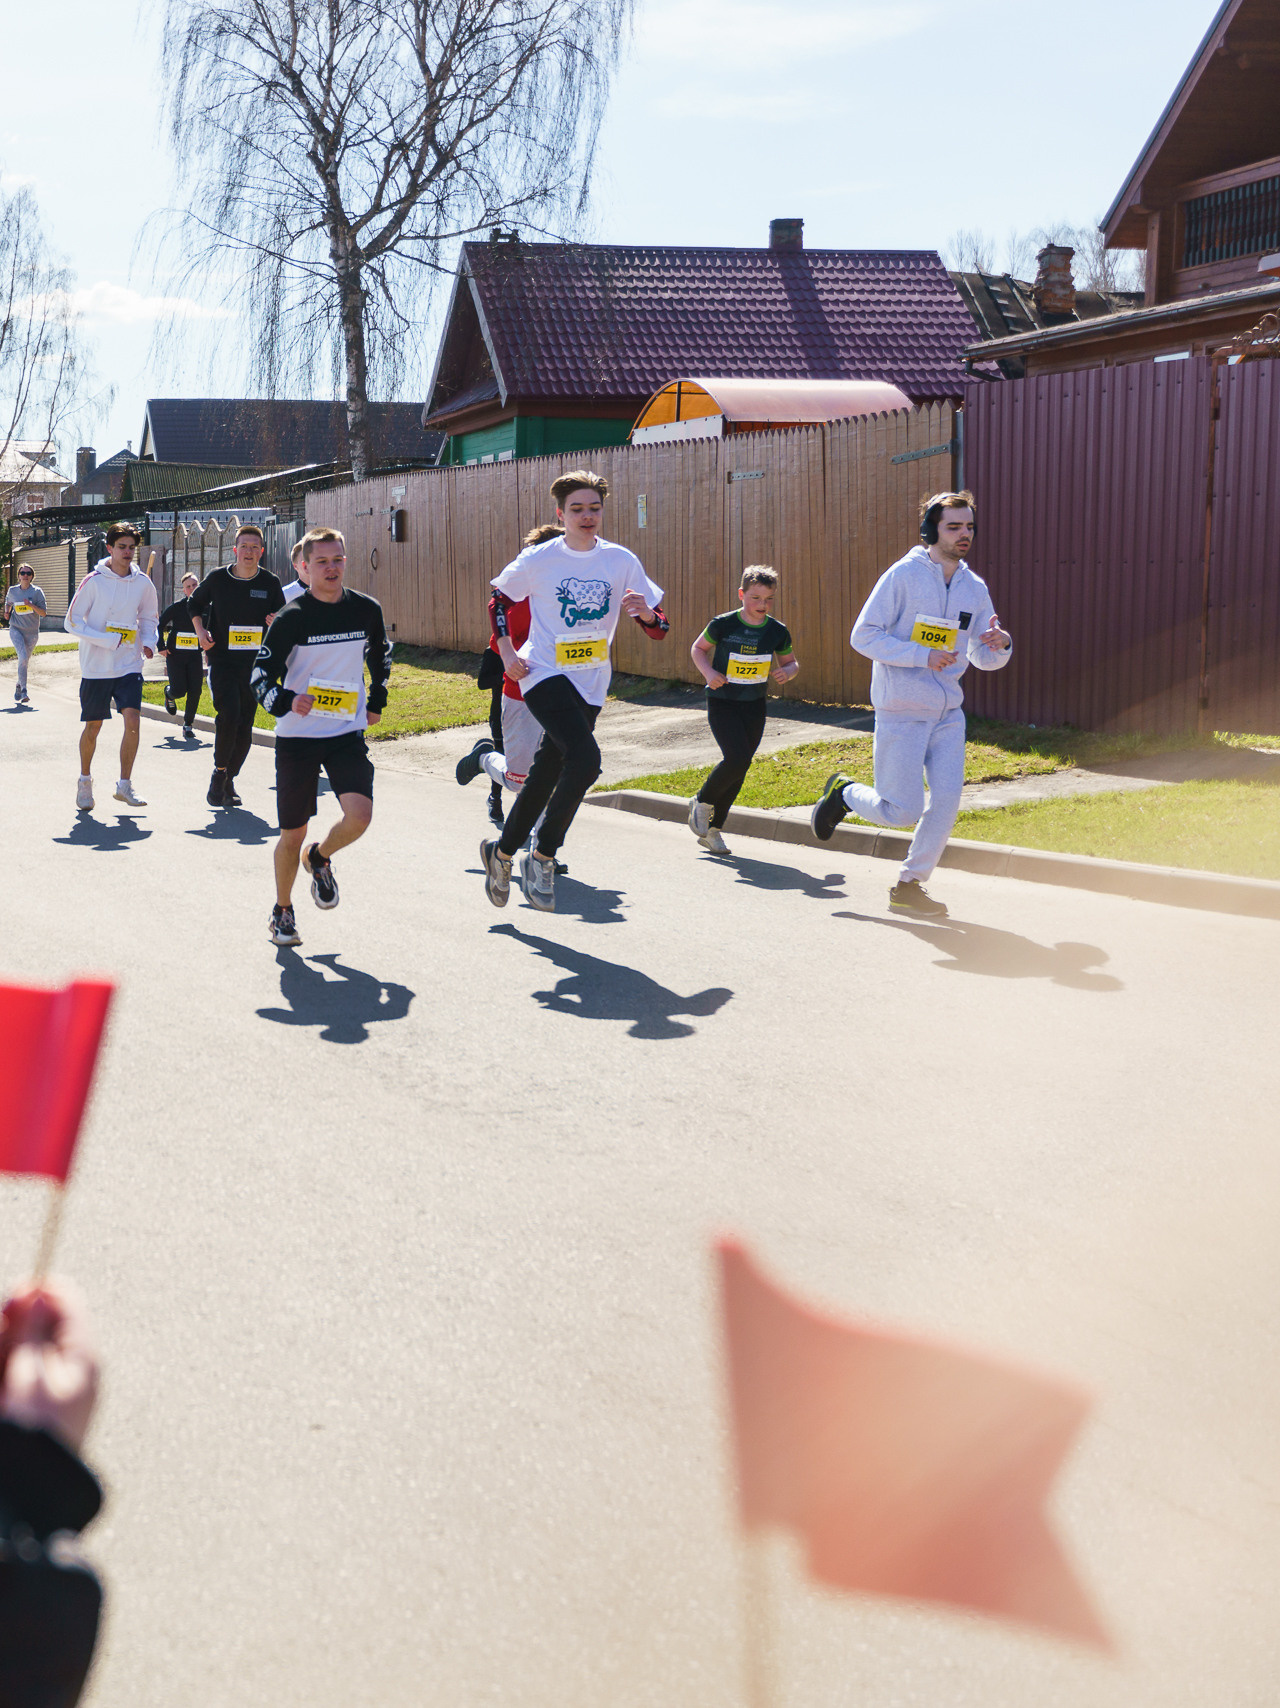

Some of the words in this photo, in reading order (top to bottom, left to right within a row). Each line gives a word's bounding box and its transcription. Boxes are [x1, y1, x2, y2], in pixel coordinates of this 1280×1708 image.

[921, 630, 947, 644] 1094
[565, 647, 593, 659] 1226
[735, 666, 758, 675] 1272
[317, 694, 343, 707] 1217
